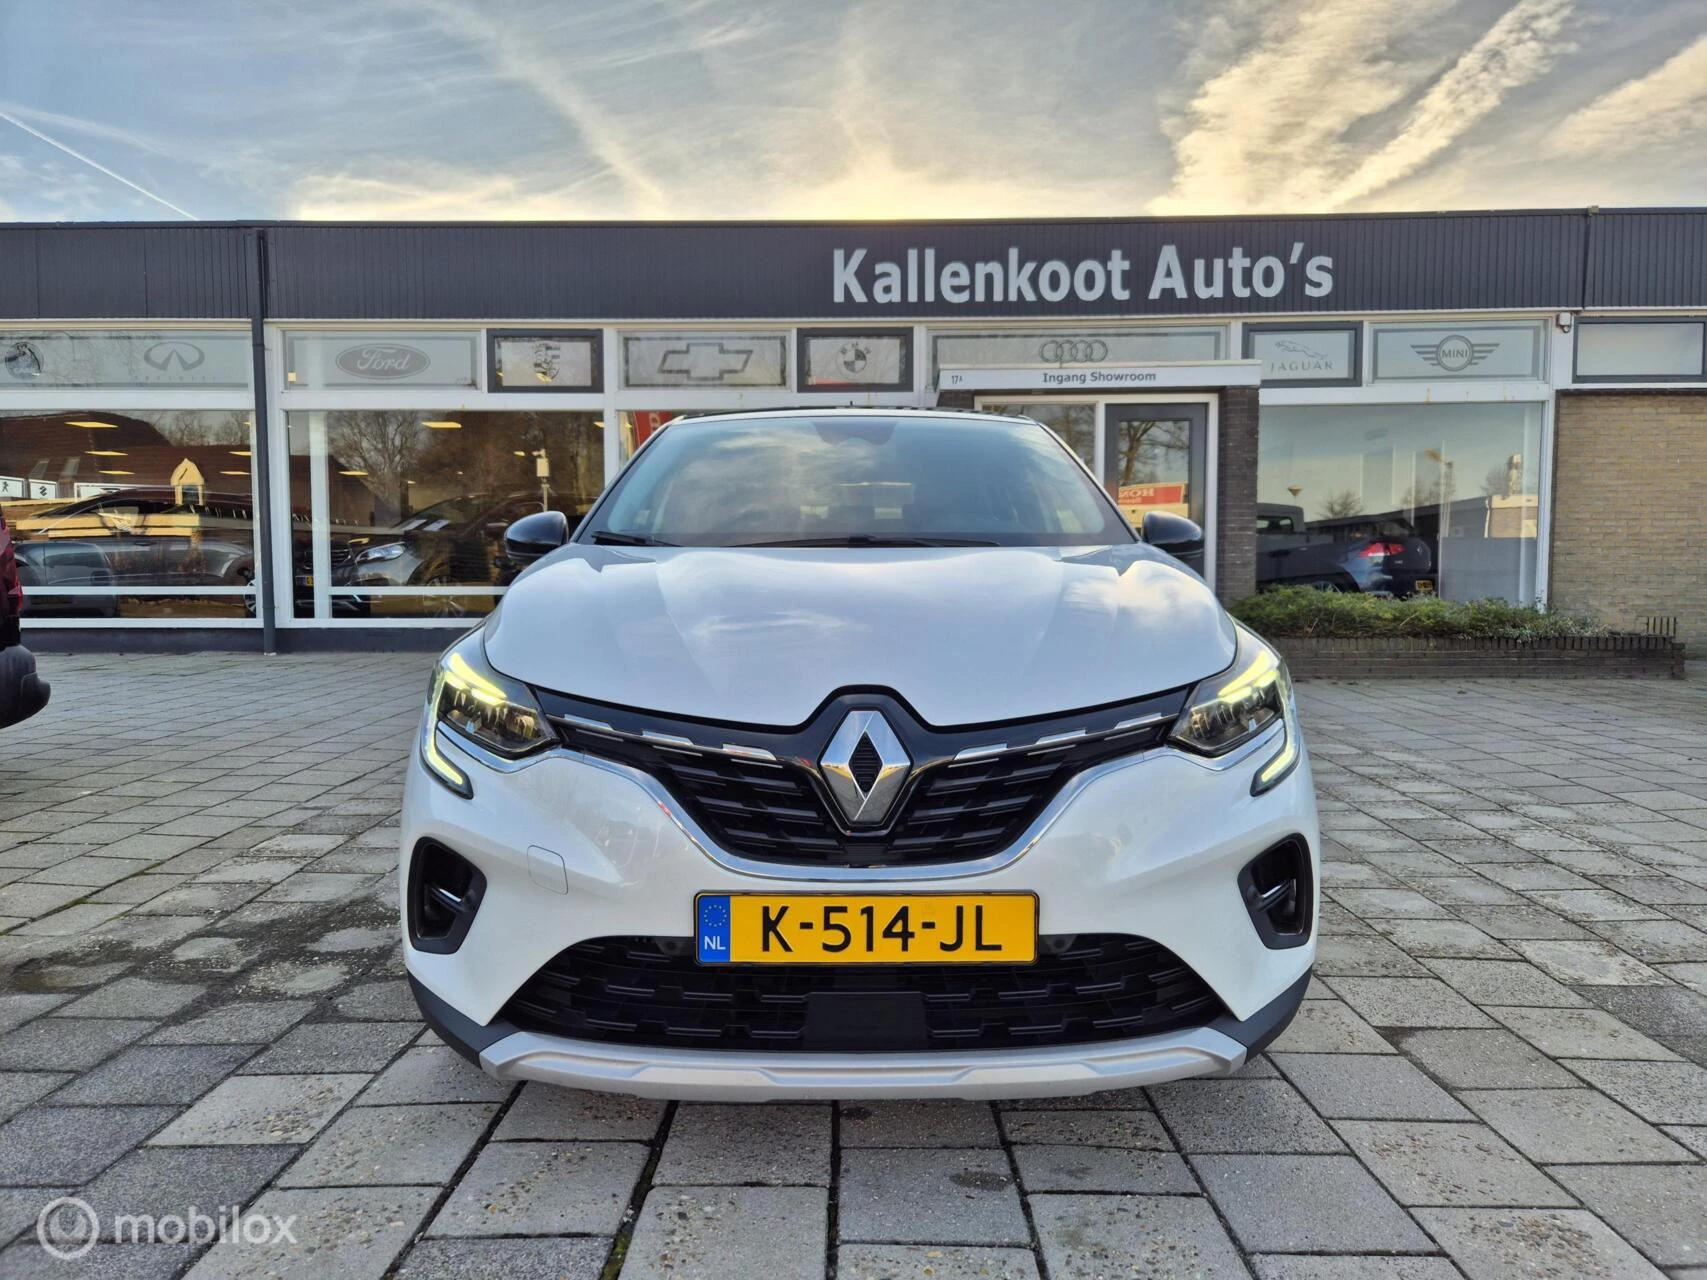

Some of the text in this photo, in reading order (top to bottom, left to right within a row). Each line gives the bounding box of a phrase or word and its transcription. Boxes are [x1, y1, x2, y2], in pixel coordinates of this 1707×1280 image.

[833, 243, 1334, 303] Kallenkoot Auto's
[356, 348, 410, 370] Ford
[1441, 348, 1468, 359] MINI
[1270, 360, 1333, 373] JAGUAR
[1043, 371, 1157, 385] Ingang Showroom
[761, 905, 1003, 953] K-514-JL
[703, 935, 726, 951] NL
